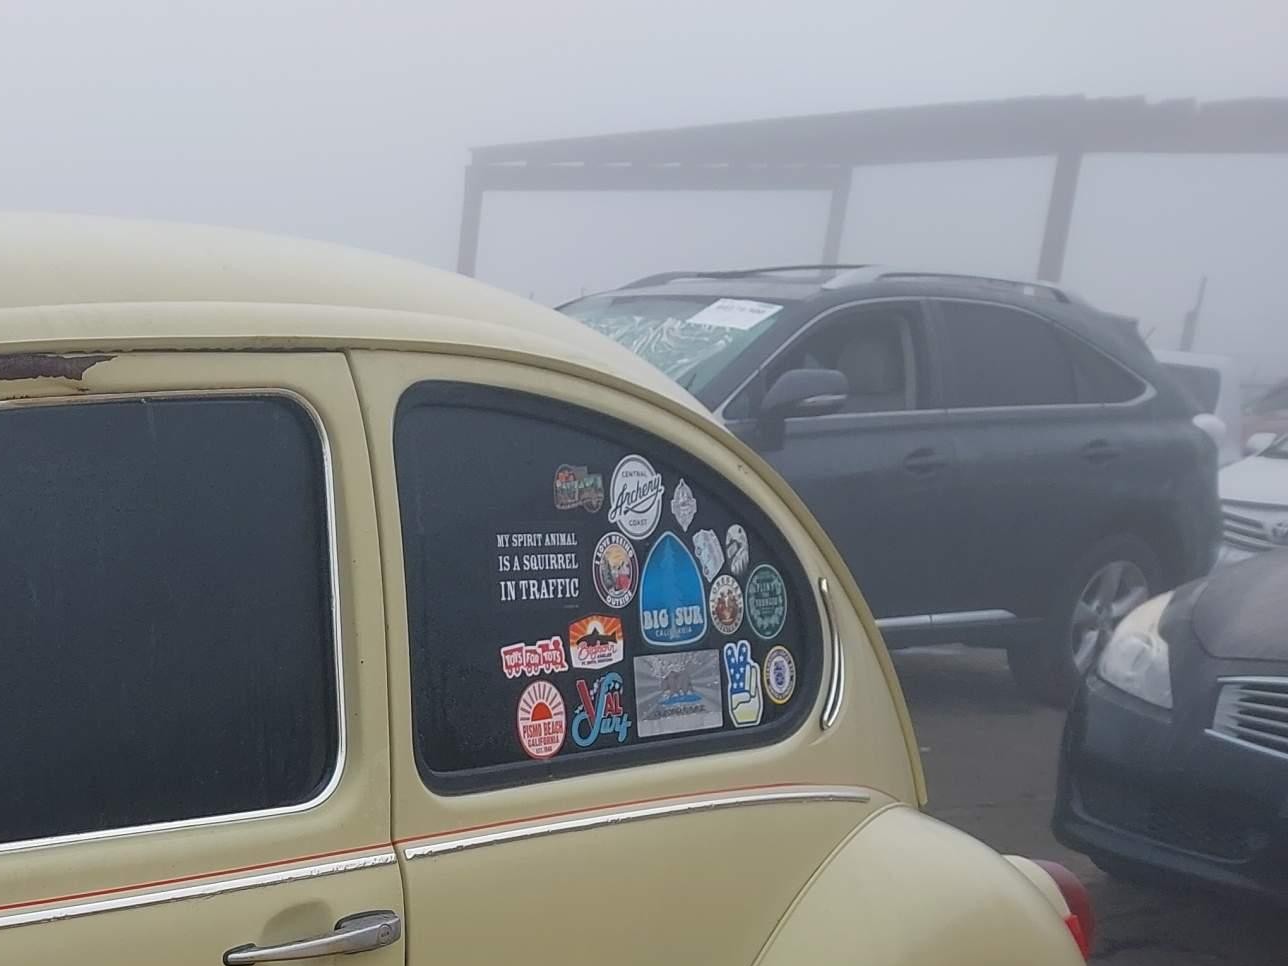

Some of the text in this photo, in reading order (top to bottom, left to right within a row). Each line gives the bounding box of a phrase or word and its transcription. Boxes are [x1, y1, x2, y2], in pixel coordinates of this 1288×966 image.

[621, 470, 648, 478] CENTRAL
[610, 476, 663, 520] Archery
[629, 519, 648, 527] COAST
[497, 533, 577, 547] MY SPIRIT ANIMAL
[597, 537, 610, 557] LOVE
[498, 553, 579, 572] IS A SQUIRREL
[500, 578, 579, 600] IN TRAFFIC
[643, 605, 704, 630] BIG SUR
[505, 651, 561, 665] TOYS FOR TOTS
[523, 721, 563, 739] PISMO BEACH
[528, 736, 559, 748] CALIFORNIA
